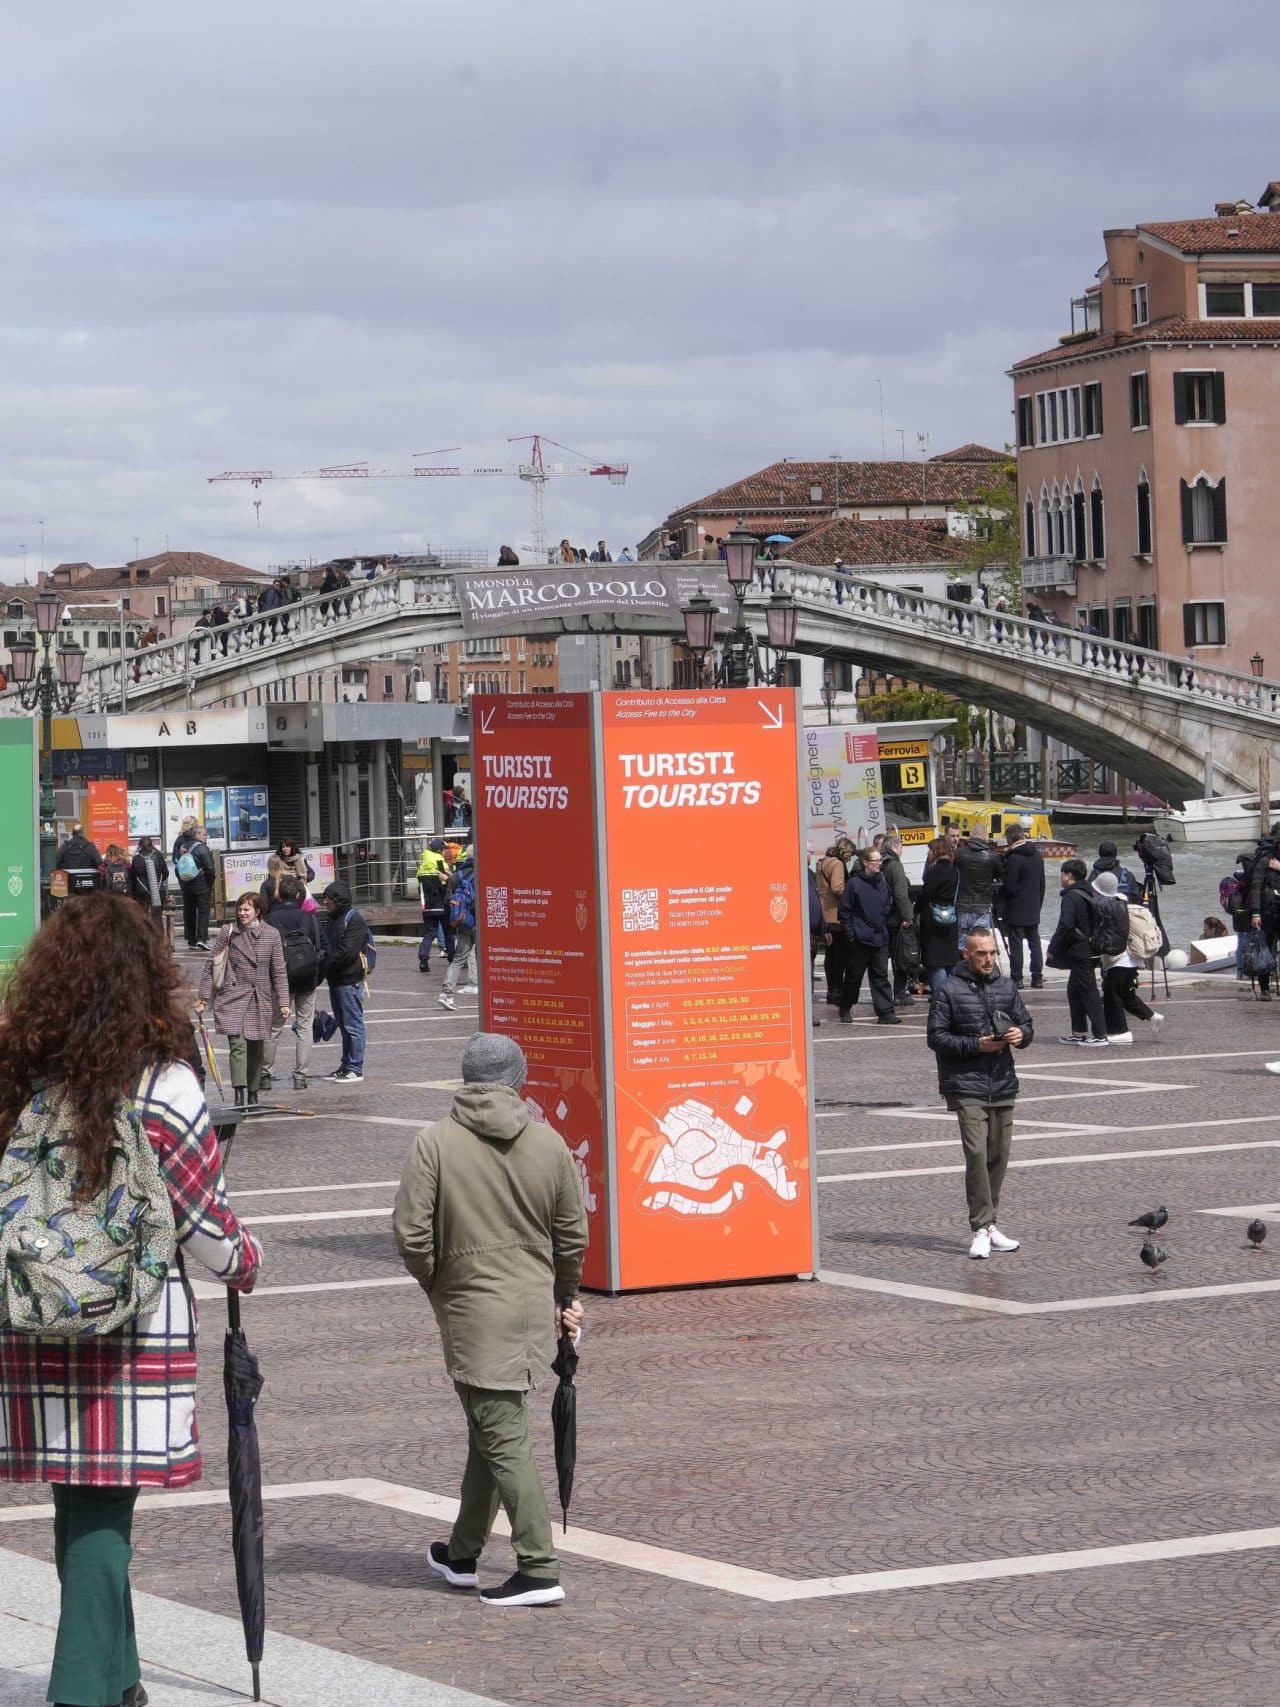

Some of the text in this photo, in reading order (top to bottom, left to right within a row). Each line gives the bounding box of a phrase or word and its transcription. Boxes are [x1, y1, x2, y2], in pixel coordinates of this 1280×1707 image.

[522, 578, 533, 587] di
[467, 581, 667, 610] MARCO POLO
[616, 698, 654, 706] Contributo
[664, 697, 695, 705] Accesso
[708, 695, 727, 704] Città
[616, 708, 697, 718] Access Fee to the City
[158, 720, 197, 737] A B
[878, 744, 920, 756] Ferrovia
[482, 754, 552, 779] TURISTI
[618, 751, 735, 778] TURISTI
[807, 731, 825, 817] Foreigners
[485, 784, 569, 810] TOURISTS
[622, 780, 762, 809] TOURISTS
[863, 766, 881, 832] Venezia
[828, 778, 848, 842] ywhere
[899, 831, 926, 841] rovia
[668, 887, 698, 895] Inquadra
[624, 971, 647, 979] Access
[631, 1002, 651, 1010] Aprile
[632, 1020, 655, 1028] Maggio
[633, 1038, 656, 1047] Giugno
[633, 1056, 654, 1065] Luglio
